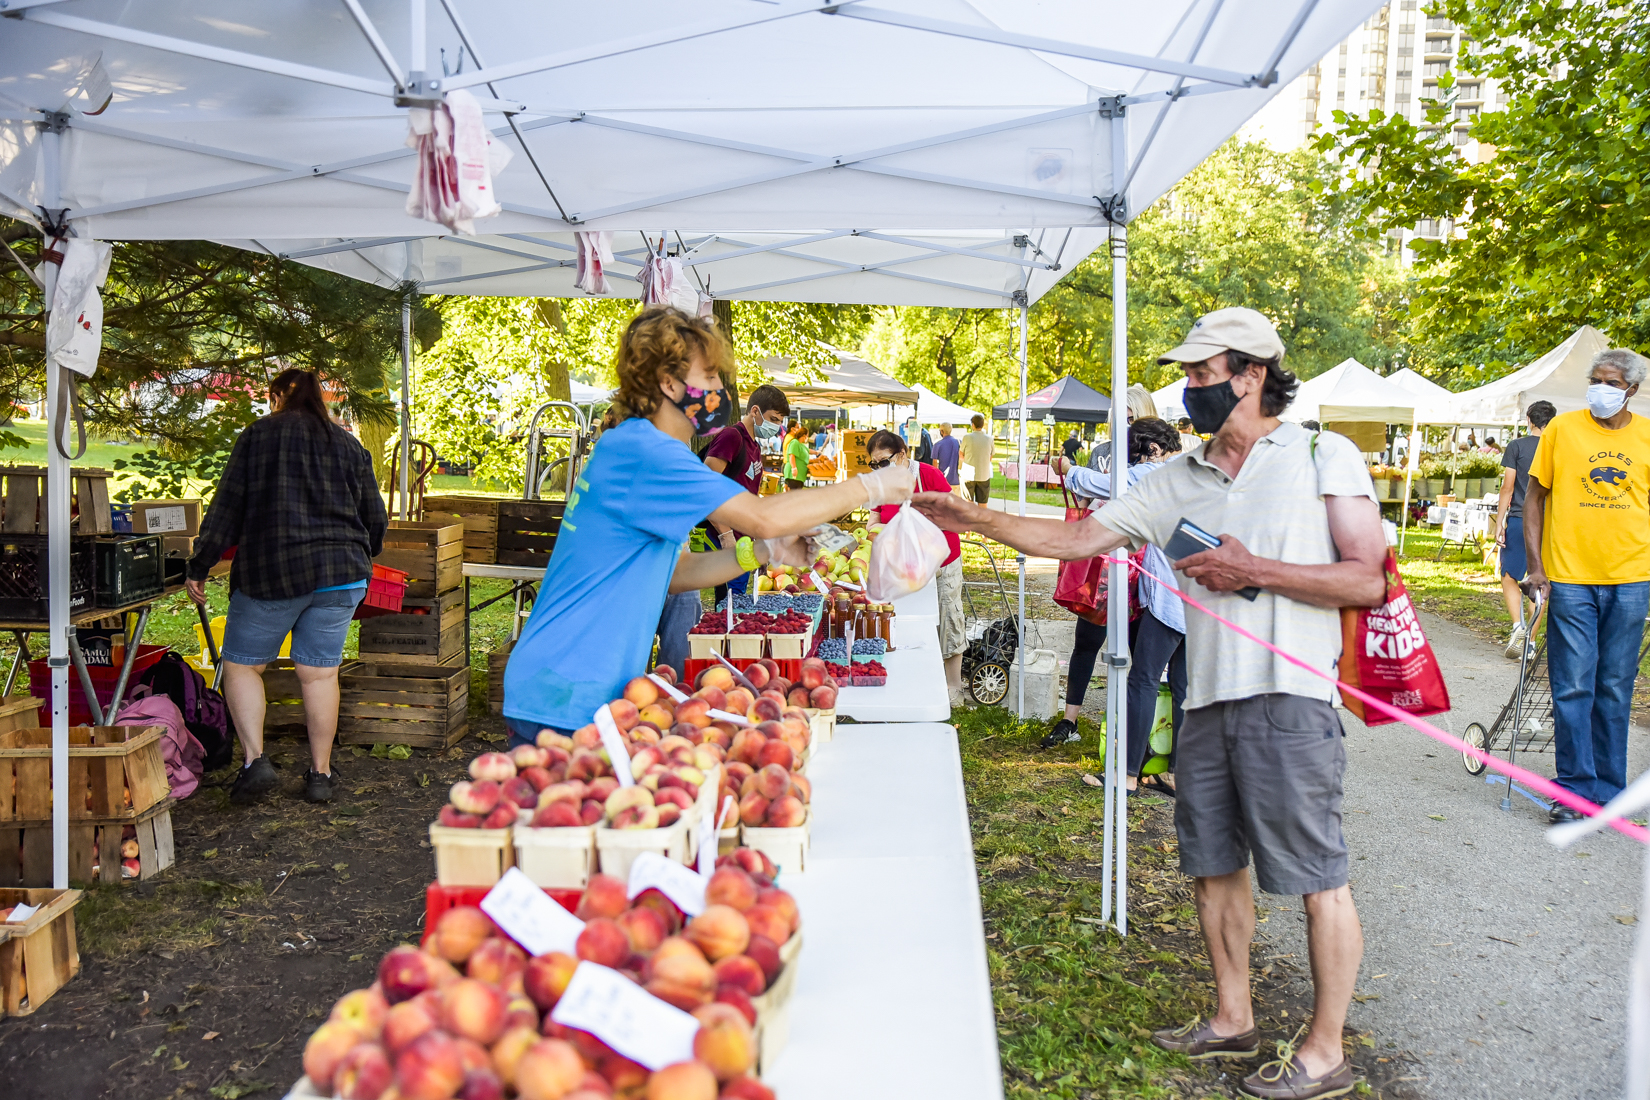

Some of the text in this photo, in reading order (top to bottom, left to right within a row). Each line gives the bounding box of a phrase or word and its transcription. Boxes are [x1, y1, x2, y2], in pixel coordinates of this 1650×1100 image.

[1008, 408, 1033, 419] RACLTE
[1588, 451, 1633, 466] COLES
[1365, 620, 1426, 659] KIDS
[82, 656, 110, 665] ADAM
